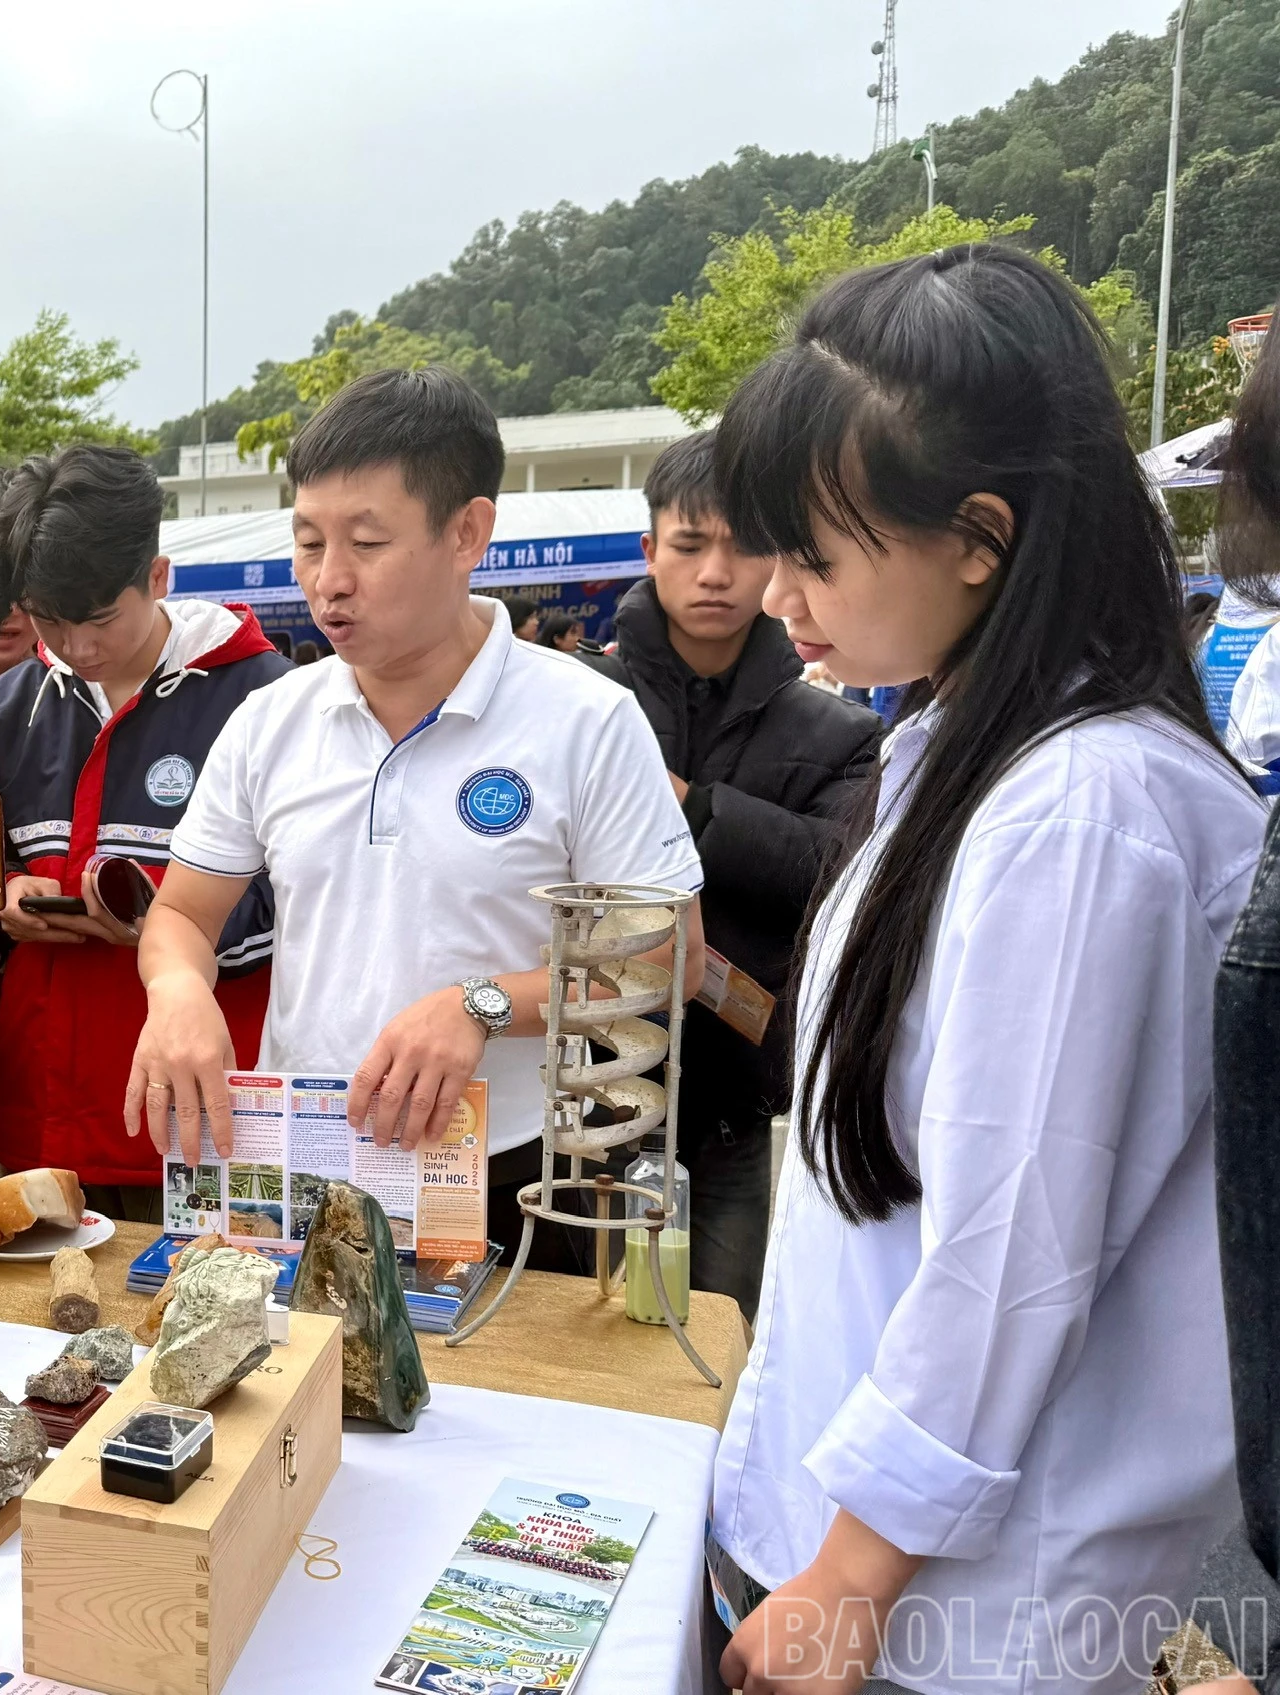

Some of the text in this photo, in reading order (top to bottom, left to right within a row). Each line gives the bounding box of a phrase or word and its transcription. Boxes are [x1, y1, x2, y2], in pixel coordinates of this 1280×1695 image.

[514, 543, 537, 566] HÀ
[543, 541, 573, 566] NỘI
[499, 793, 515, 801] MDC
[424, 1149, 459, 1161] TUYỂN
[423, 1162, 448, 1170] SINH
[471, 1154, 479, 1187] 2025
[423, 1173, 468, 1186] ĐẠI HỌC
[526, 1515, 595, 1535] KHOA HỌC
[543, 1511, 582, 1525] KHOA
[516, 1522, 596, 1544] & KỸ THUẬT
[520, 1533, 585, 1552] ĐỊA CHẤT
